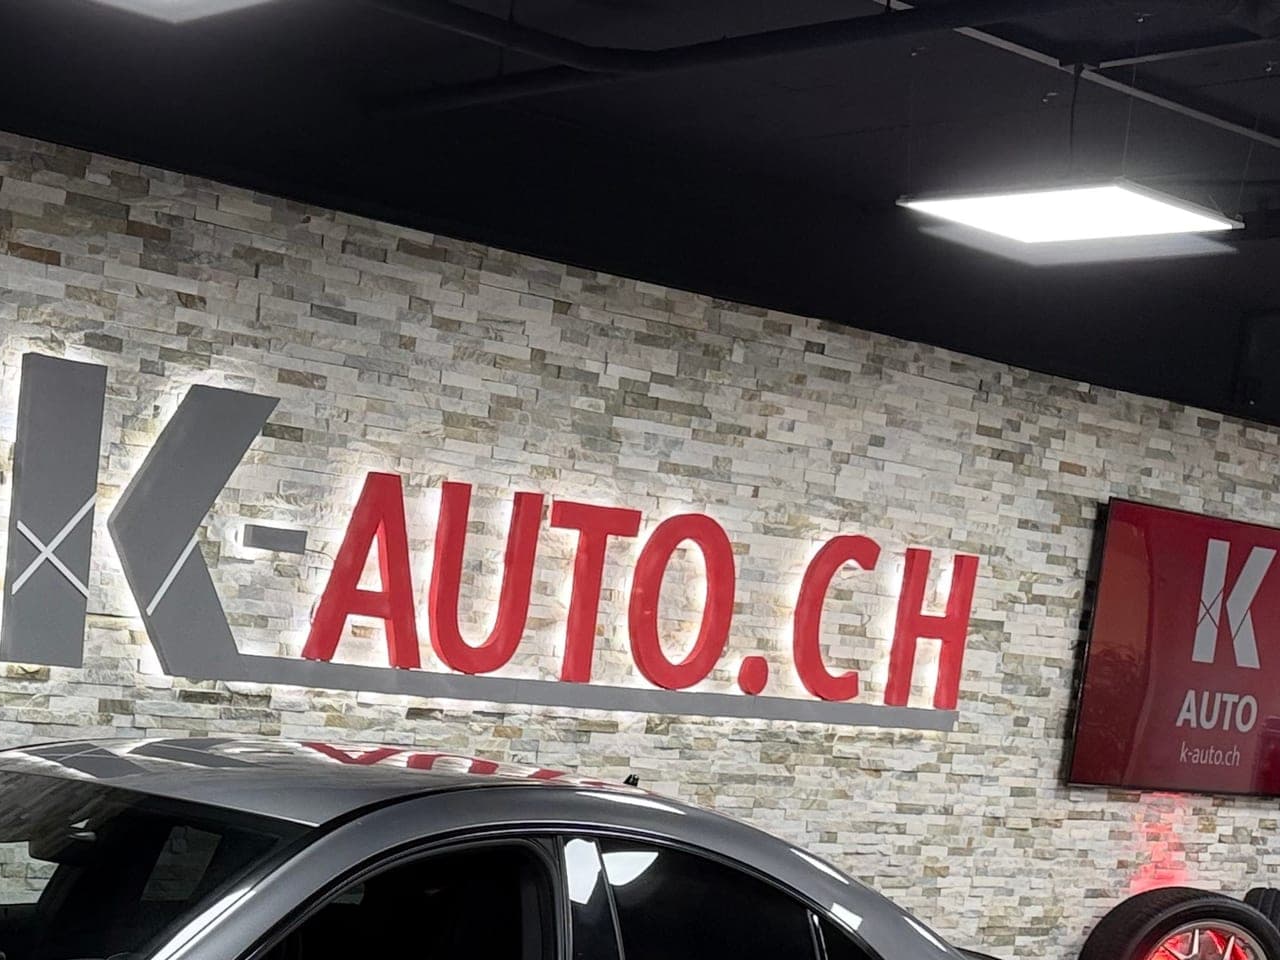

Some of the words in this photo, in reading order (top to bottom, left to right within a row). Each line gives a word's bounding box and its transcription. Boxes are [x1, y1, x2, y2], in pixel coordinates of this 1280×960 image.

[0, 353, 978, 710] K-AUTO.CH
[1192, 538, 1277, 669] K
[1176, 689, 1258, 732] AUTO
[1179, 741, 1240, 767] k-auto.ch
